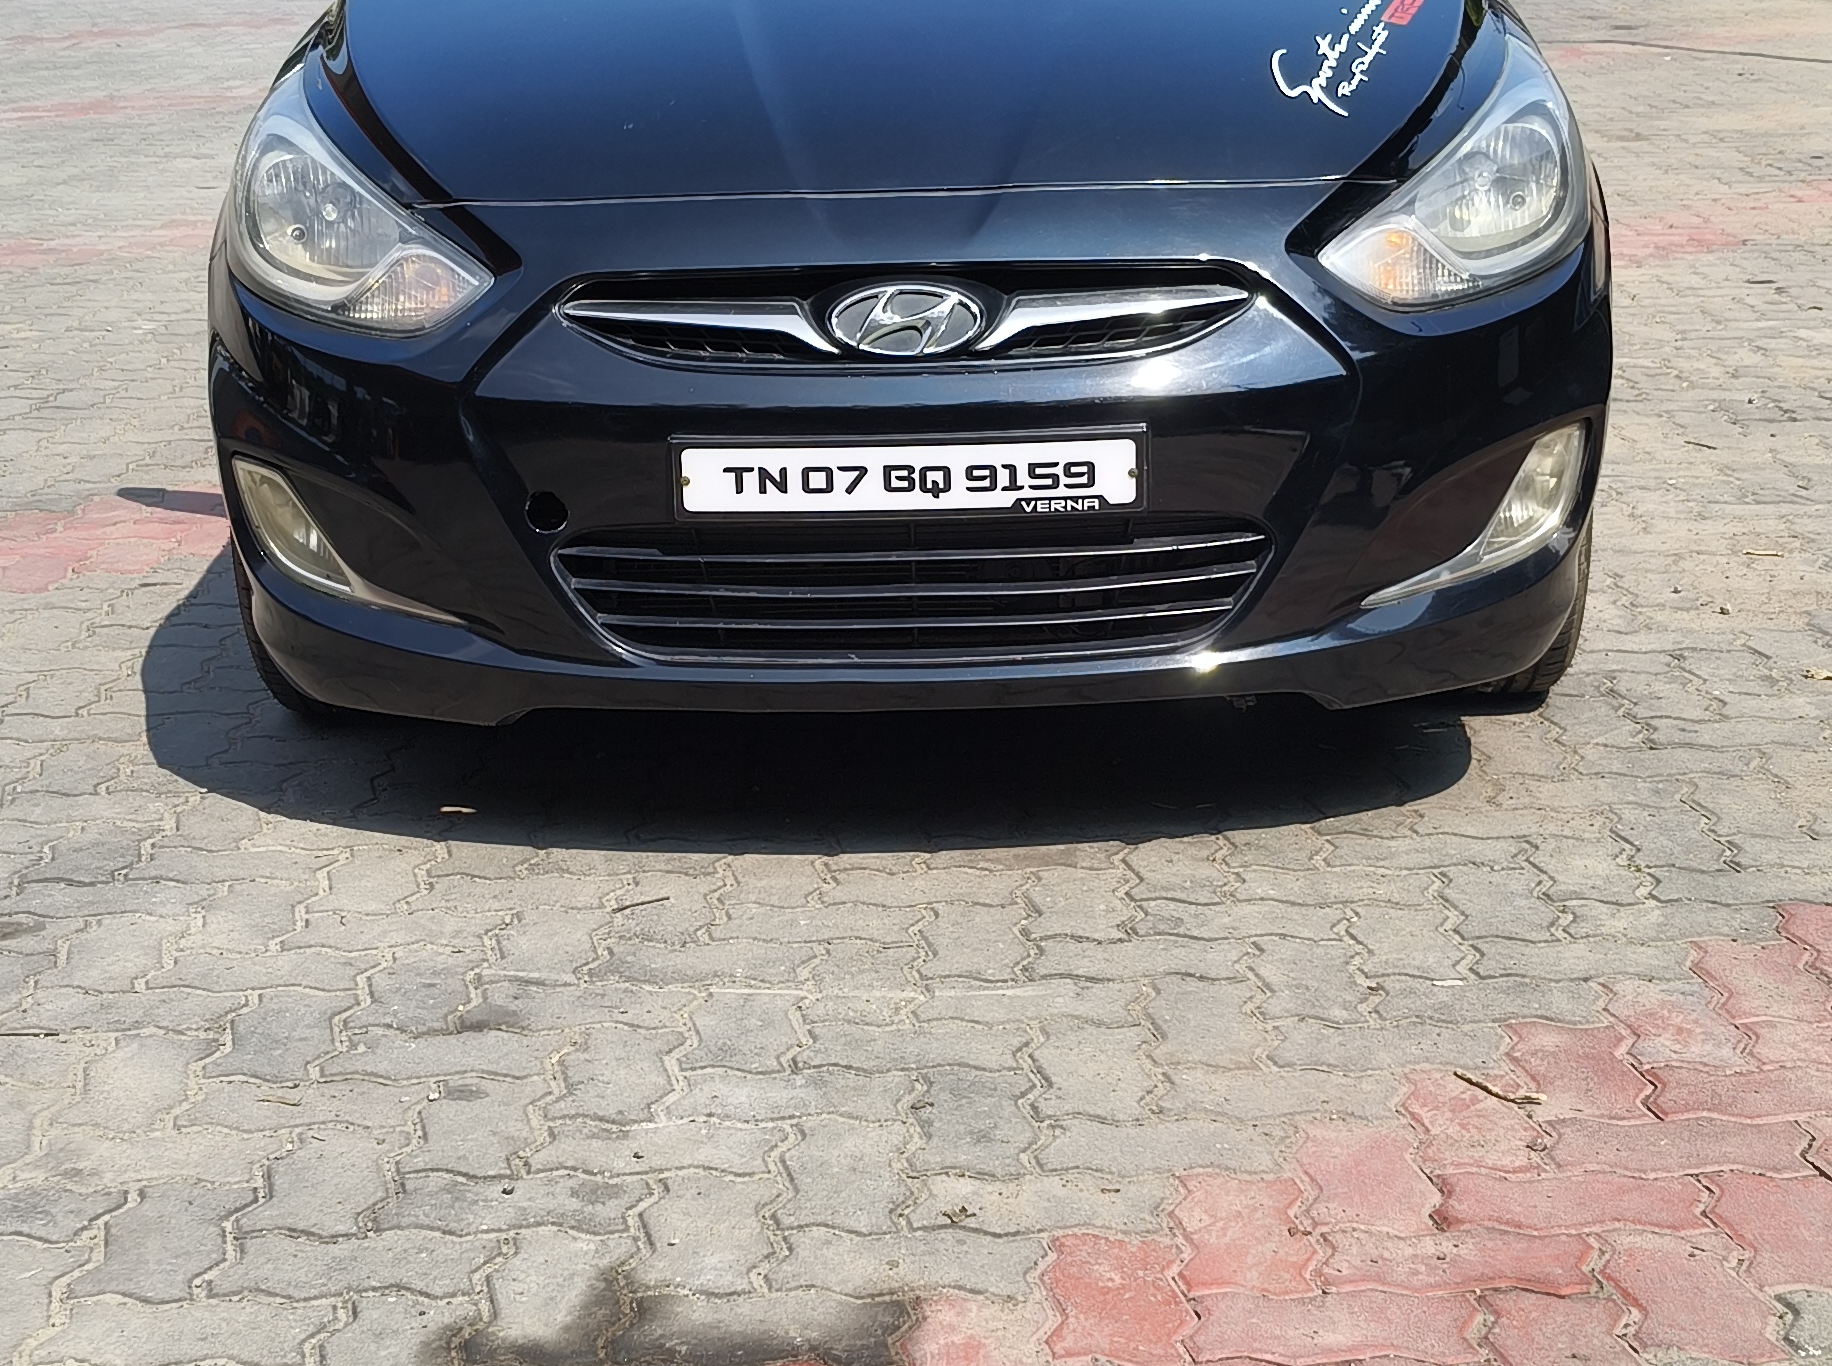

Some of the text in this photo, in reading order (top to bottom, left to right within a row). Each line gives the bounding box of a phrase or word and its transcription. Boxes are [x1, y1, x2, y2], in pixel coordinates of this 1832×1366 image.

[722, 460, 1096, 499] TN 07 BQ 9159
[1020, 497, 1100, 513] VERNA
